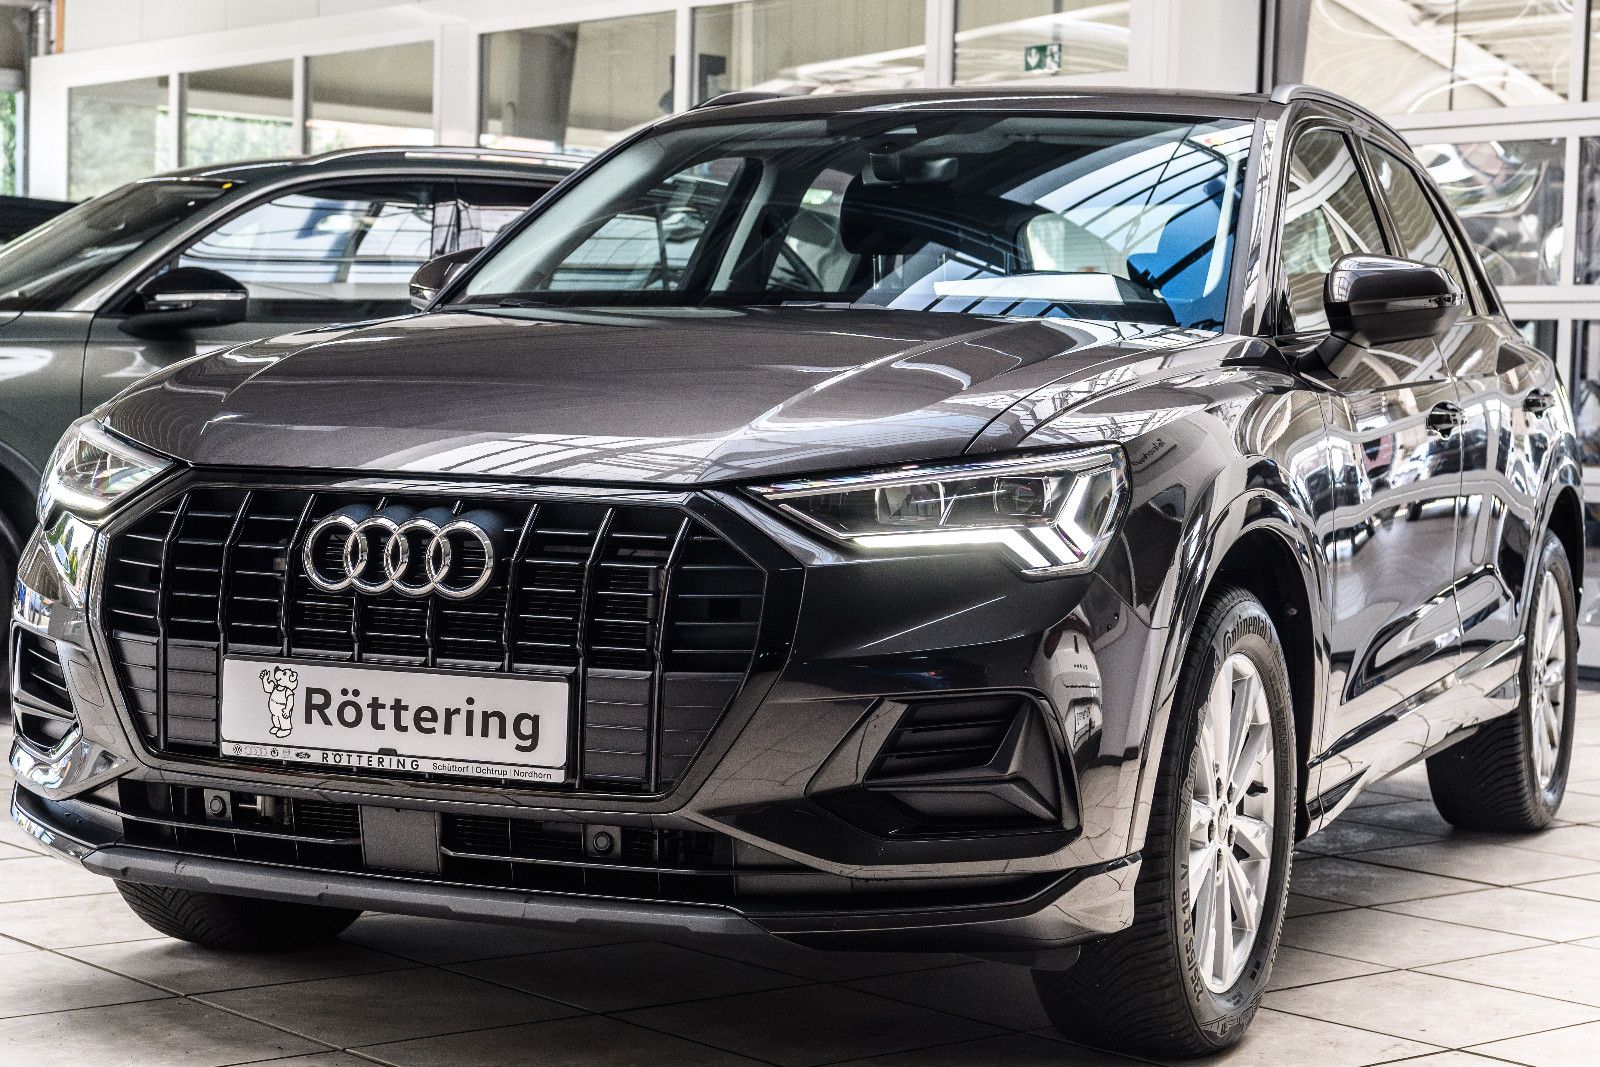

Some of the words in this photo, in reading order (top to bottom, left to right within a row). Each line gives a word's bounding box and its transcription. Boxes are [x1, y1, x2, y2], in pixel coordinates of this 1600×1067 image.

[304, 686, 540, 753] Röttering
[321, 752, 420, 771] RÖTTERING
[432, 762, 469, 773] Schüttorf
[475, 766, 508, 776] Ochtrup
[513, 769, 552, 780] Nordhorn
